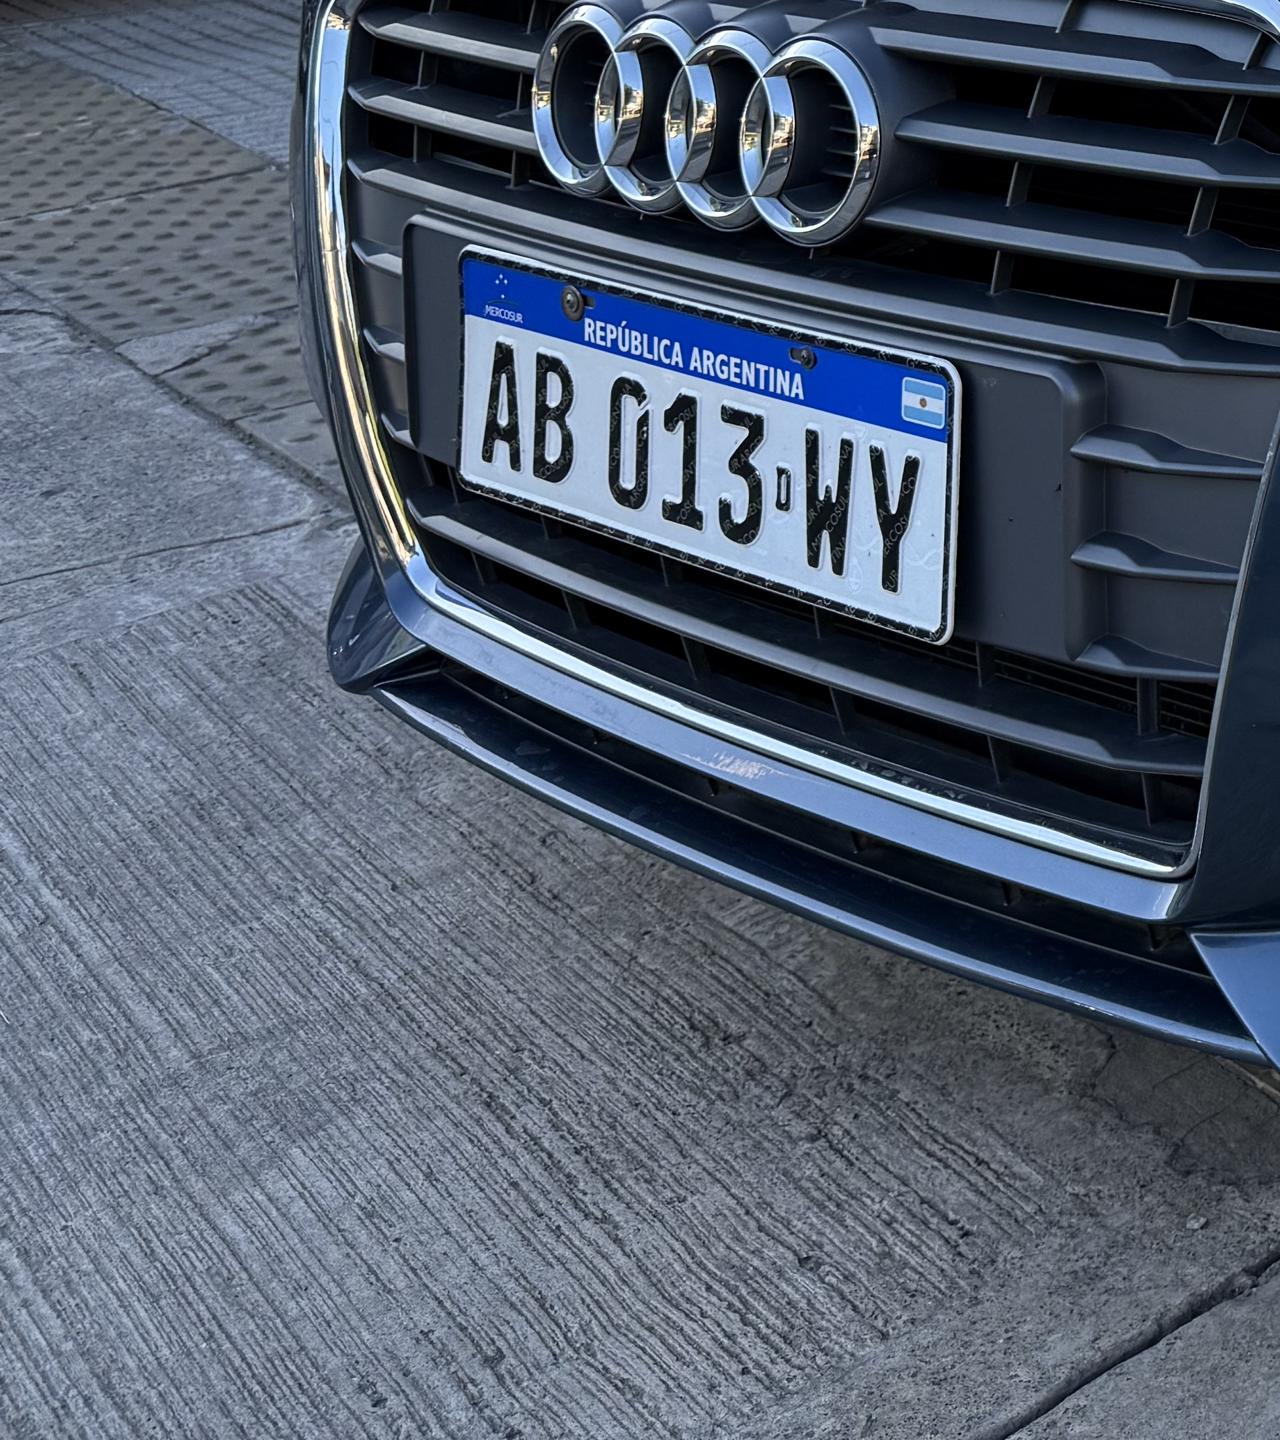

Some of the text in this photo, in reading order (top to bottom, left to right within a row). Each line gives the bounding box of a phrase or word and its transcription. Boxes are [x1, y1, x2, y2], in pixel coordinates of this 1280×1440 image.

[482, 304, 525, 324] MERCOSUR
[583, 317, 805, 401] REPÚBLICA ARGENTINA
[481, 339, 575, 484] AB
[608, 374, 766, 546] 013
[804, 427, 921, 594] WY
